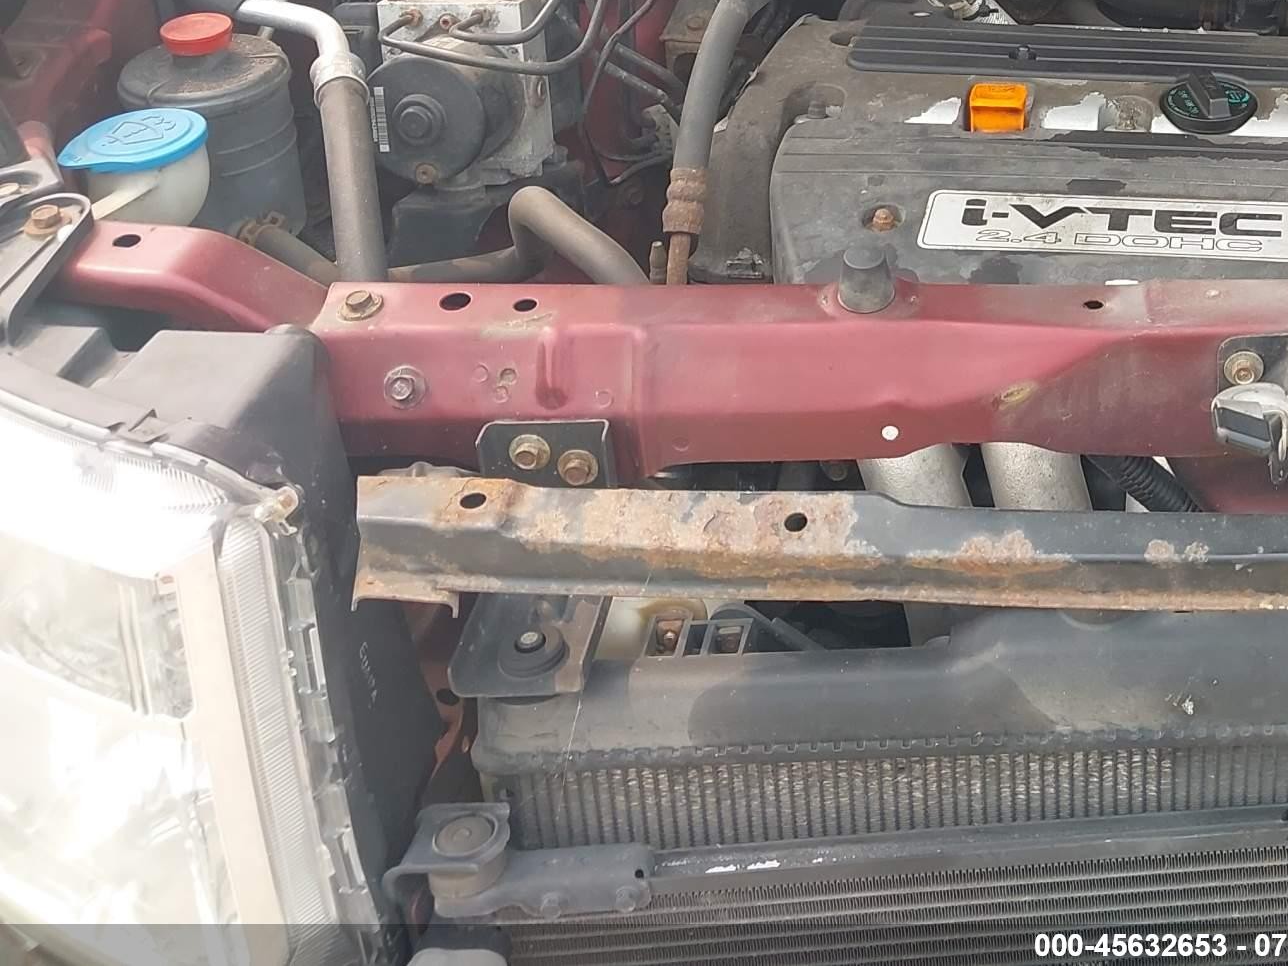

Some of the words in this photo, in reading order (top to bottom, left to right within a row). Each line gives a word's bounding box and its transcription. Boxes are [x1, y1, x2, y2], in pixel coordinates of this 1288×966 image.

[962, 199, 1283, 237] i-VTEC
[975, 229, 1062, 245] 2.4
[1074, 232, 1263, 253] DOHC
